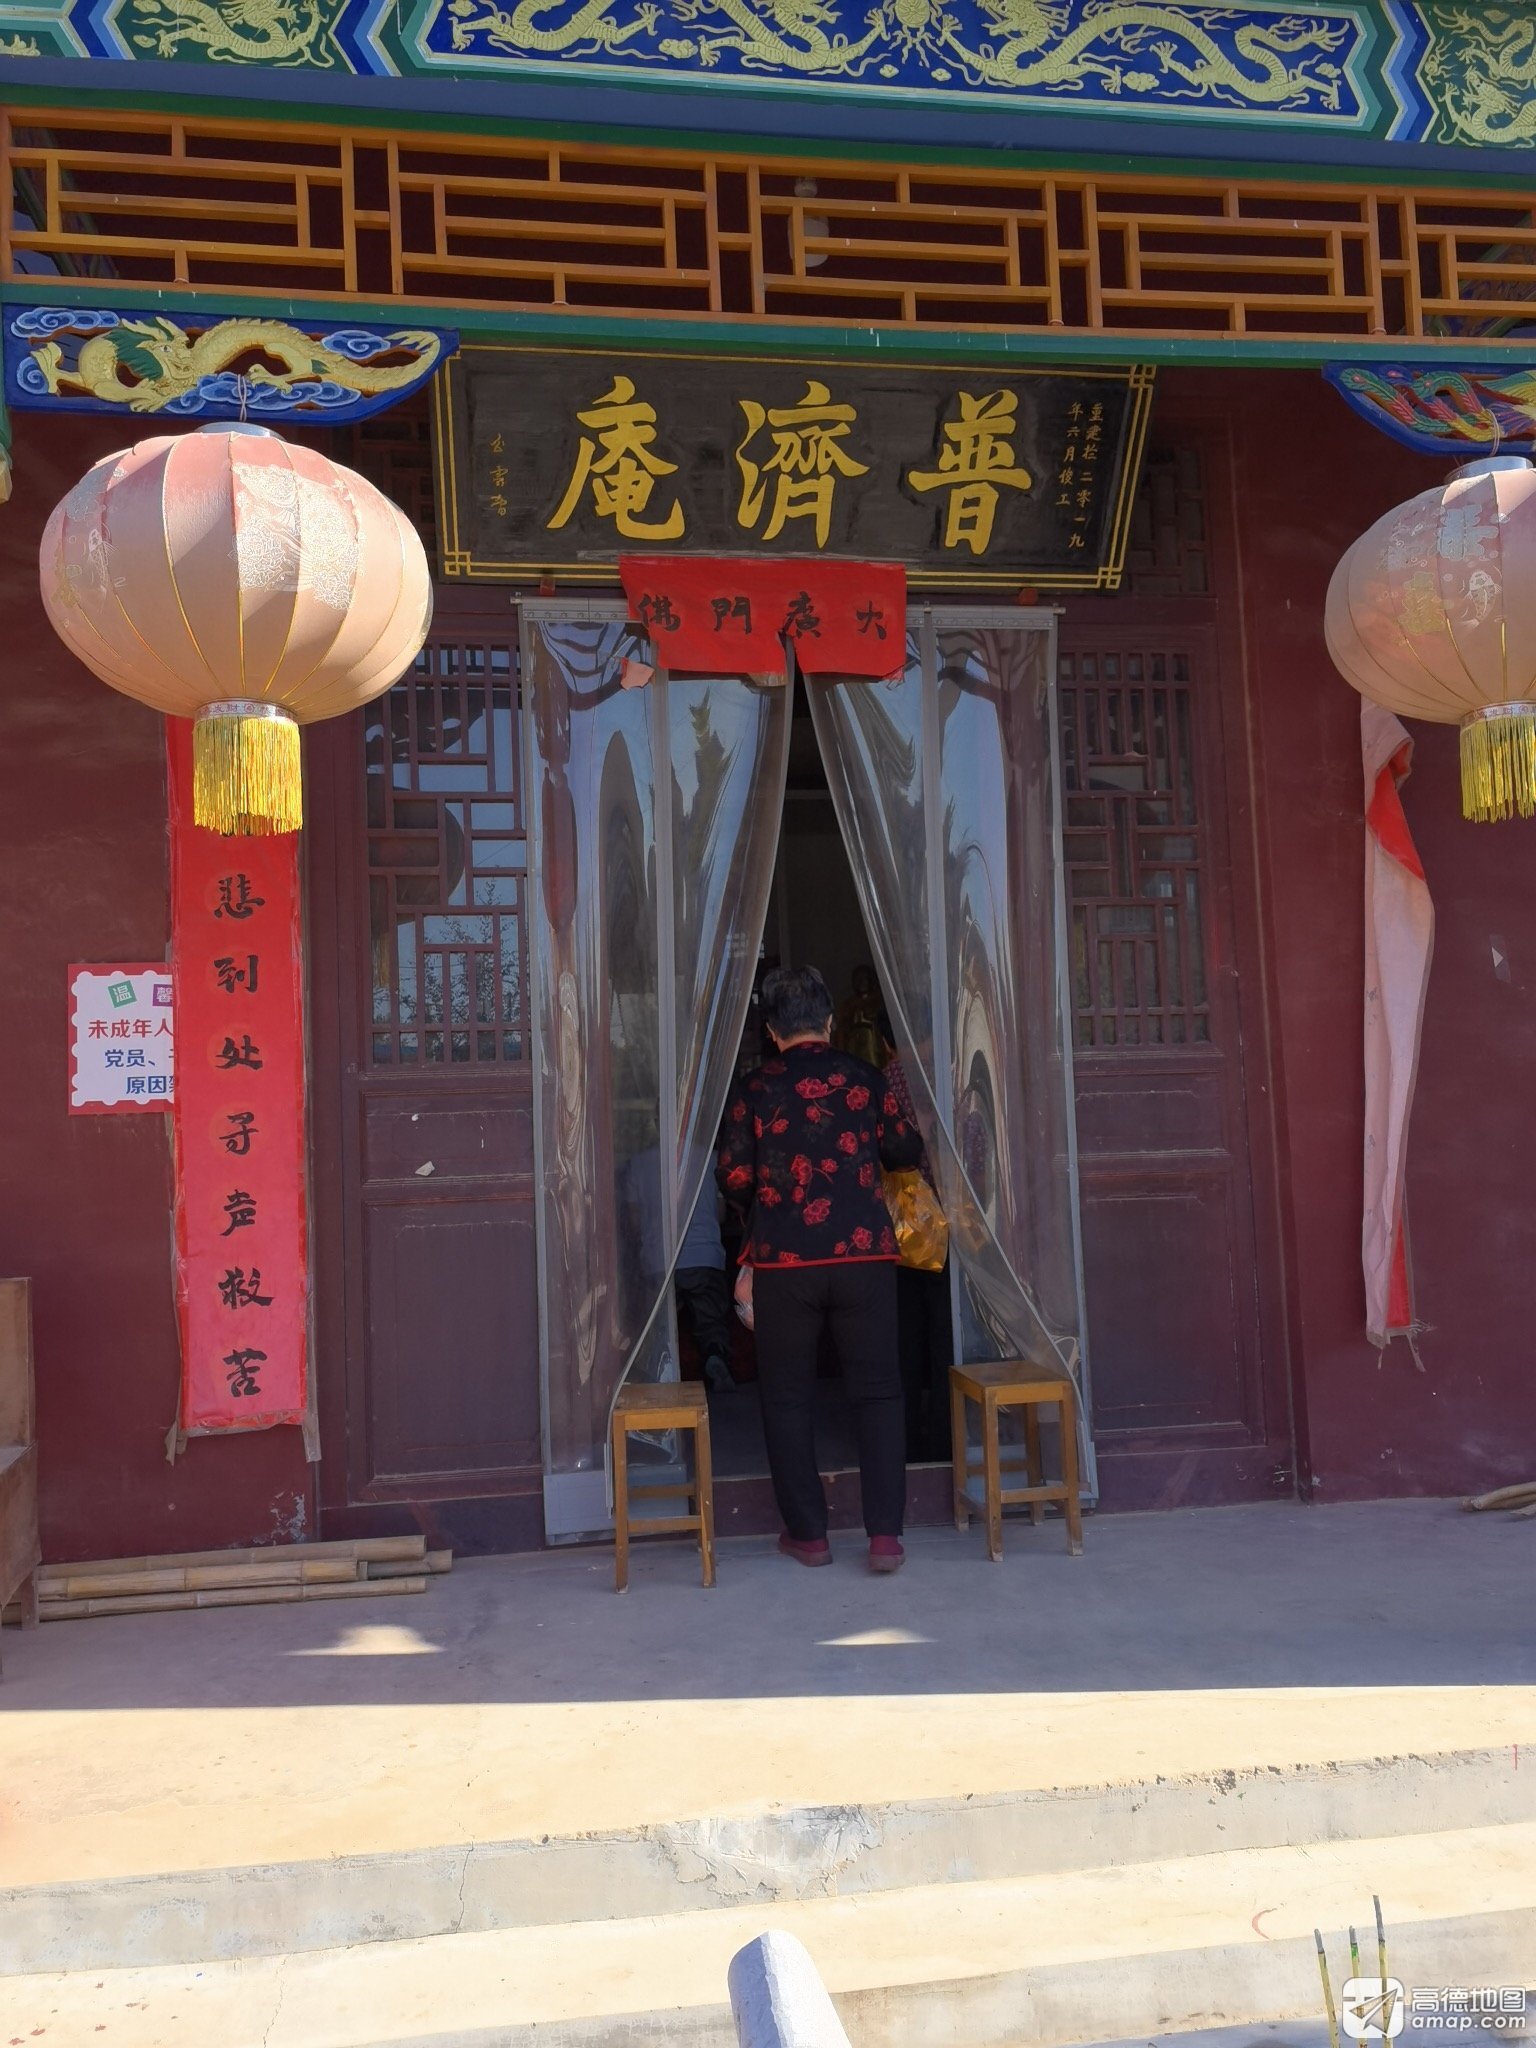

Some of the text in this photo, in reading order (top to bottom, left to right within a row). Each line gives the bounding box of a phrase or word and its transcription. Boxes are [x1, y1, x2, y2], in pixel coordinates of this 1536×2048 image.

[546, 376, 1032, 555] 普濟庵
[88, 1018, 174, 1039] 未成年人
[104, 1048, 174, 1068] 党员、
[213, 813, 274, 1398] 悲到处寻声救苦
